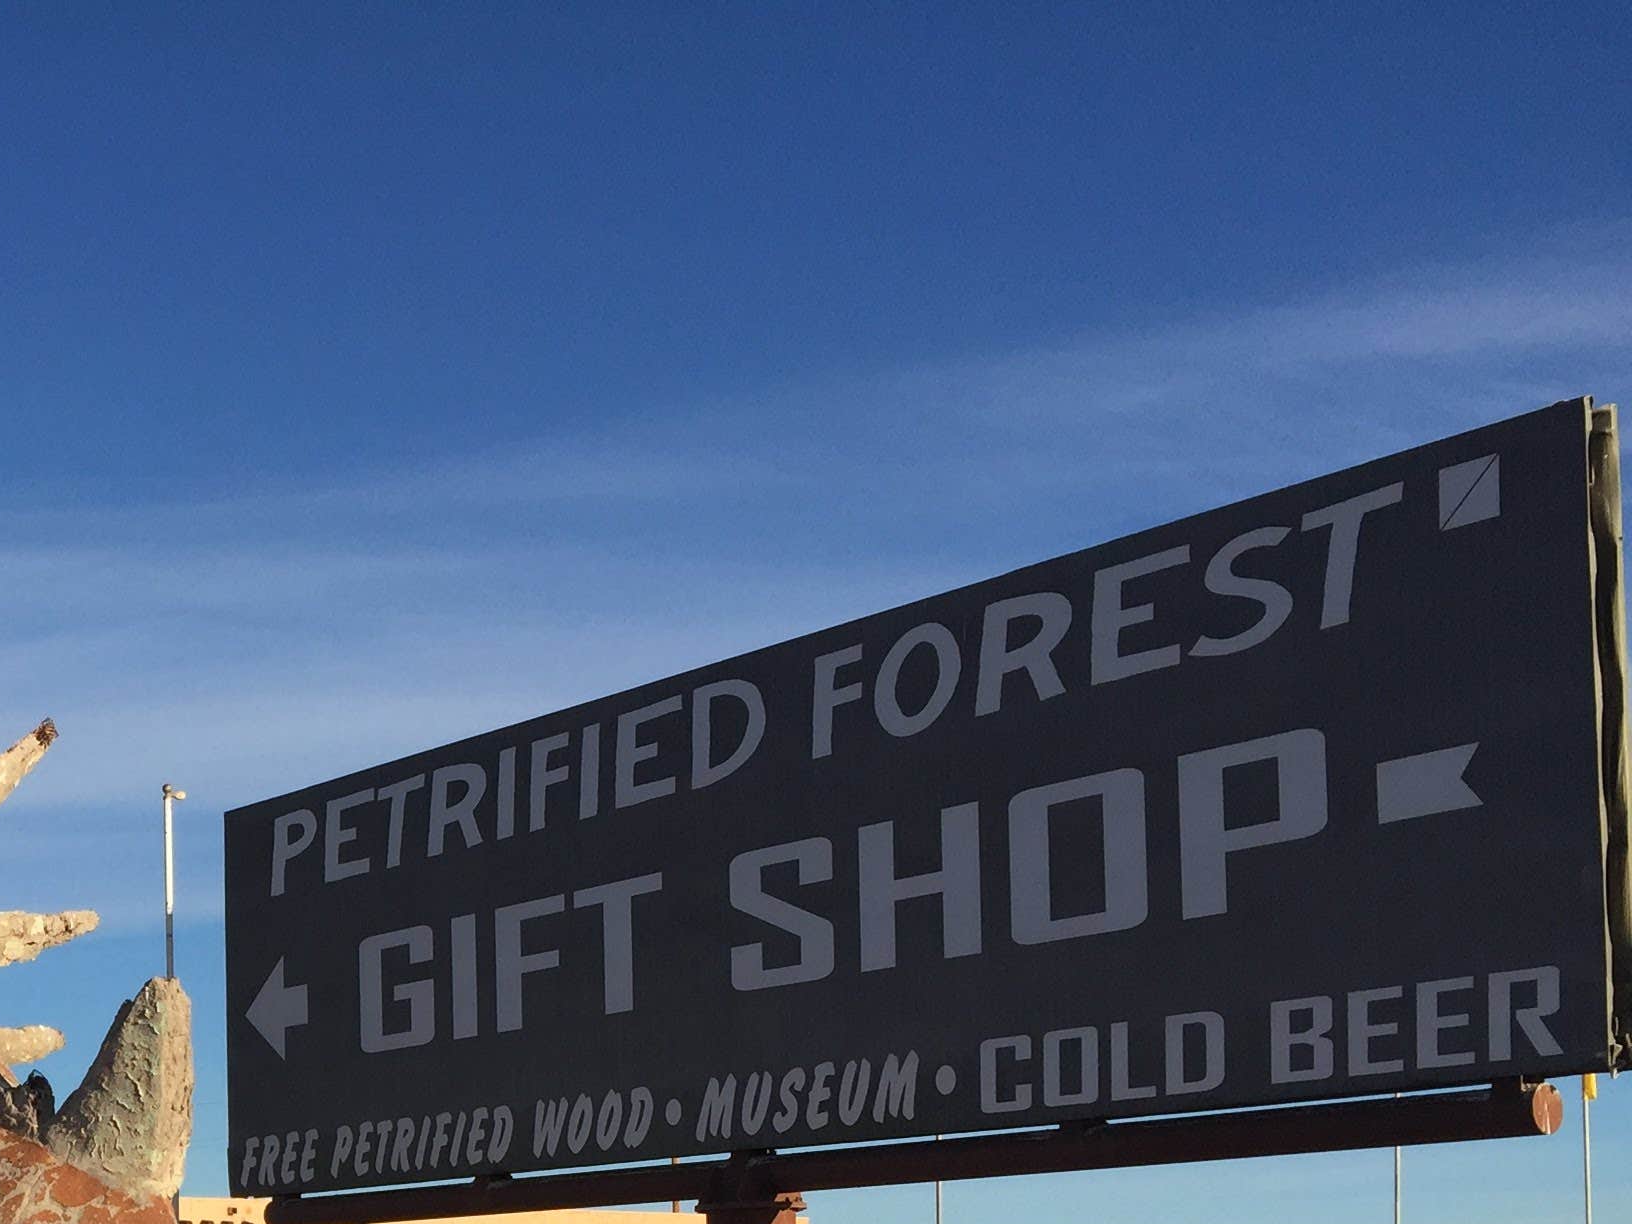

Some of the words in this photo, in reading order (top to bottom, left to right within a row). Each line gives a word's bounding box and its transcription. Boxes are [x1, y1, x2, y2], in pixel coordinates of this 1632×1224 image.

[271, 680, 765, 896] PETRIFIED
[813, 483, 1403, 758] FOREST
[359, 872, 662, 1053] GIFT
[729, 729, 1327, 991] SHOP
[240, 1129, 318, 1187] FREE
[330, 1105, 514, 1179] PETRIFIED
[533, 1087, 654, 1159] WOOD
[695, 1051, 919, 1142] MUSEUM
[980, 1012, 1225, 1113] COLD
[1271, 966, 1563, 1084] BEER
